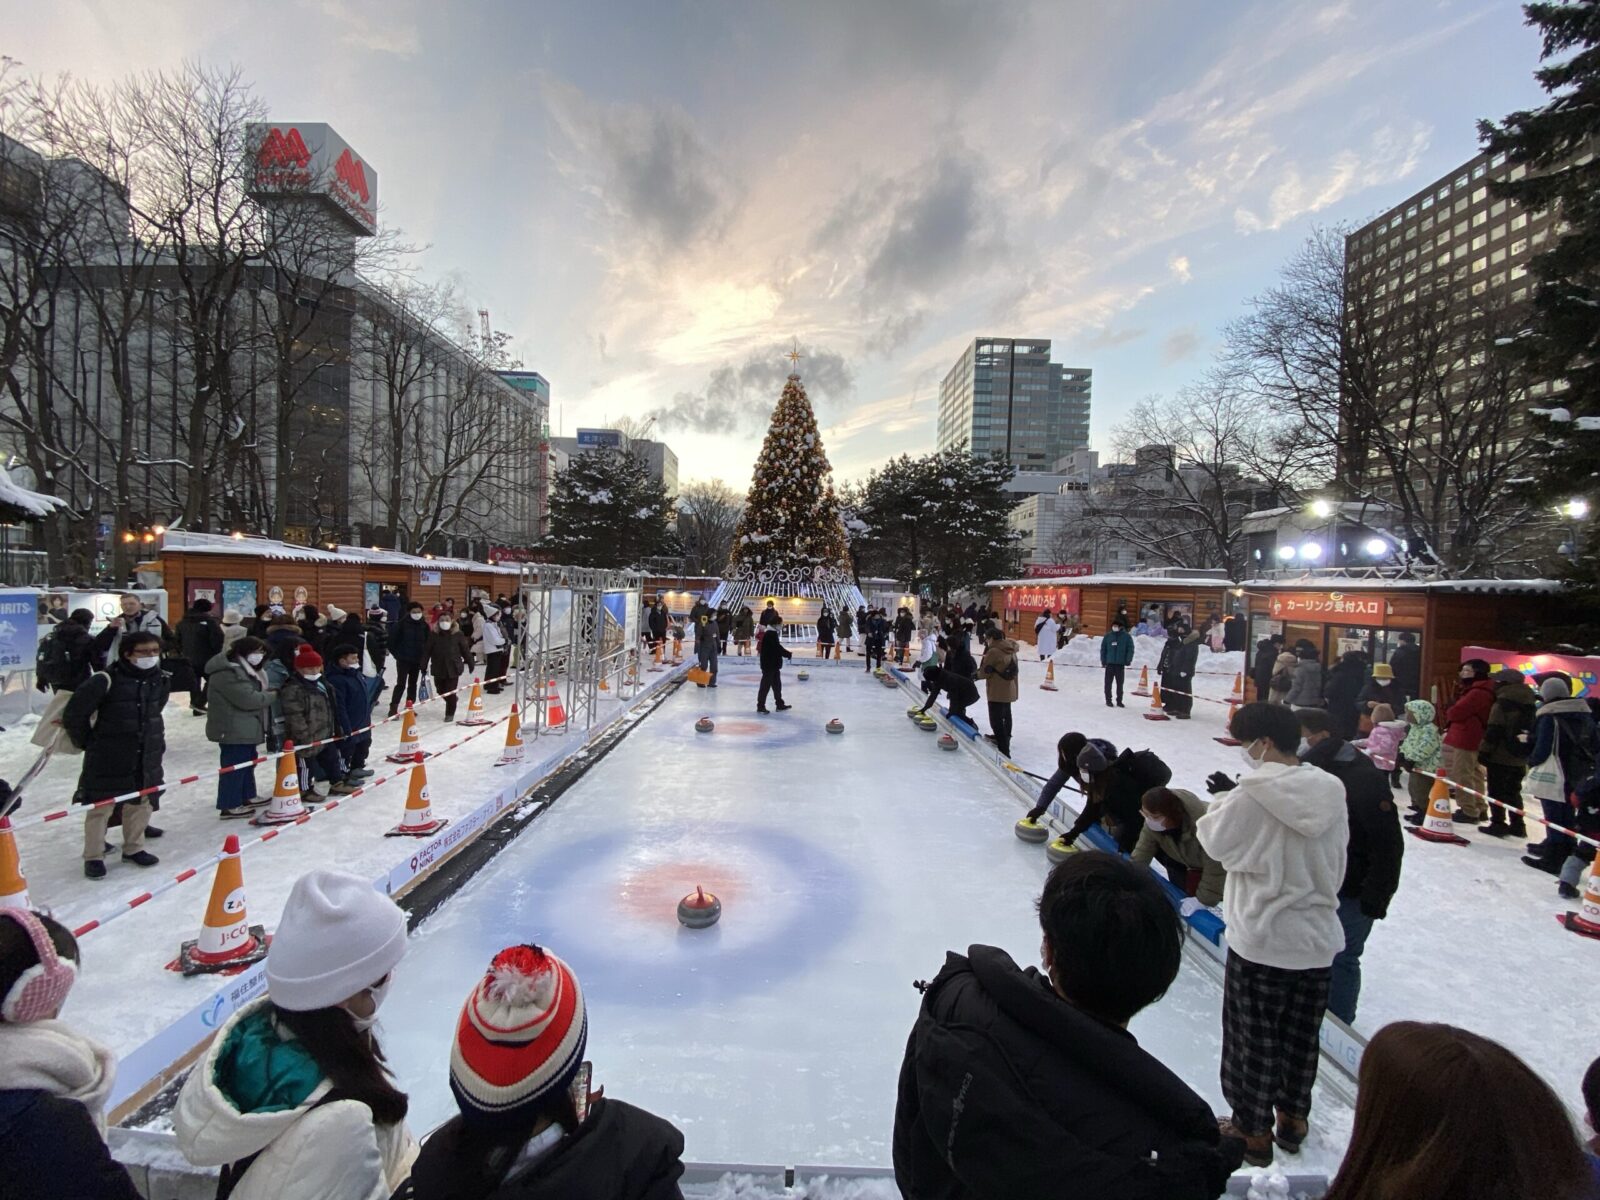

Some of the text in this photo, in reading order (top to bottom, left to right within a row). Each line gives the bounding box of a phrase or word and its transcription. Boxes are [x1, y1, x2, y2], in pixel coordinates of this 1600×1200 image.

[1018, 593, 1056, 608] J:COMひろば
[1287, 600, 1378, 614] カーリング受付入口
[420, 839, 442, 858] FACTOR
[420, 854, 434, 870] NINE
